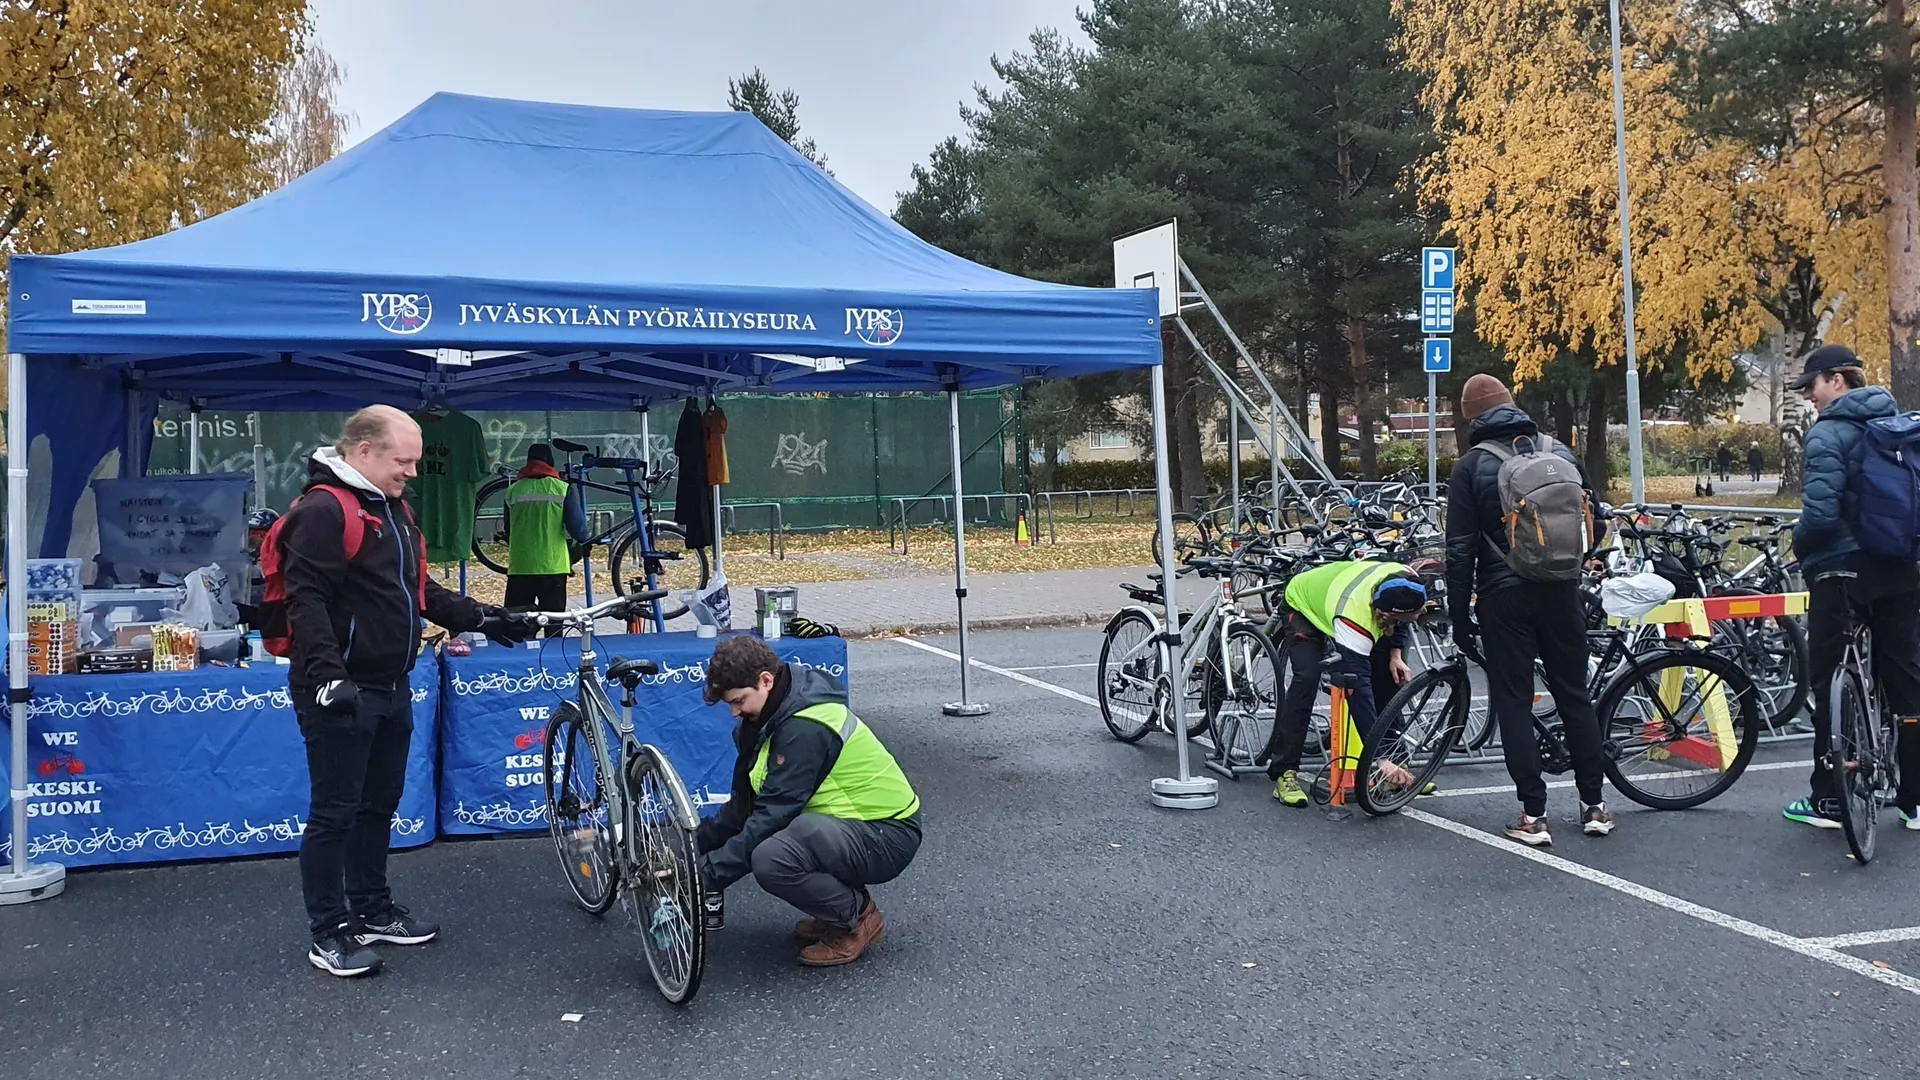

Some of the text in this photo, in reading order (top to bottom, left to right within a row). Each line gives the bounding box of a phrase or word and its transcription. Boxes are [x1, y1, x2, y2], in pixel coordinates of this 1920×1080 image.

[1428, 251, 1449, 286] P
[361, 293, 419, 322] JYPS
[459, 302, 817, 331] JYVÄSKYLÄN PYÖRÄILYSEURA
[844, 307, 893, 335] JYPS
[153, 413, 255, 438] tennis.f
[519, 706, 550, 720] WE
[42, 731, 78, 746] WE
[27, 781, 102, 797] KESKI-
[505, 771, 563, 787] SUO
[27, 800, 101, 817] SUOMI
